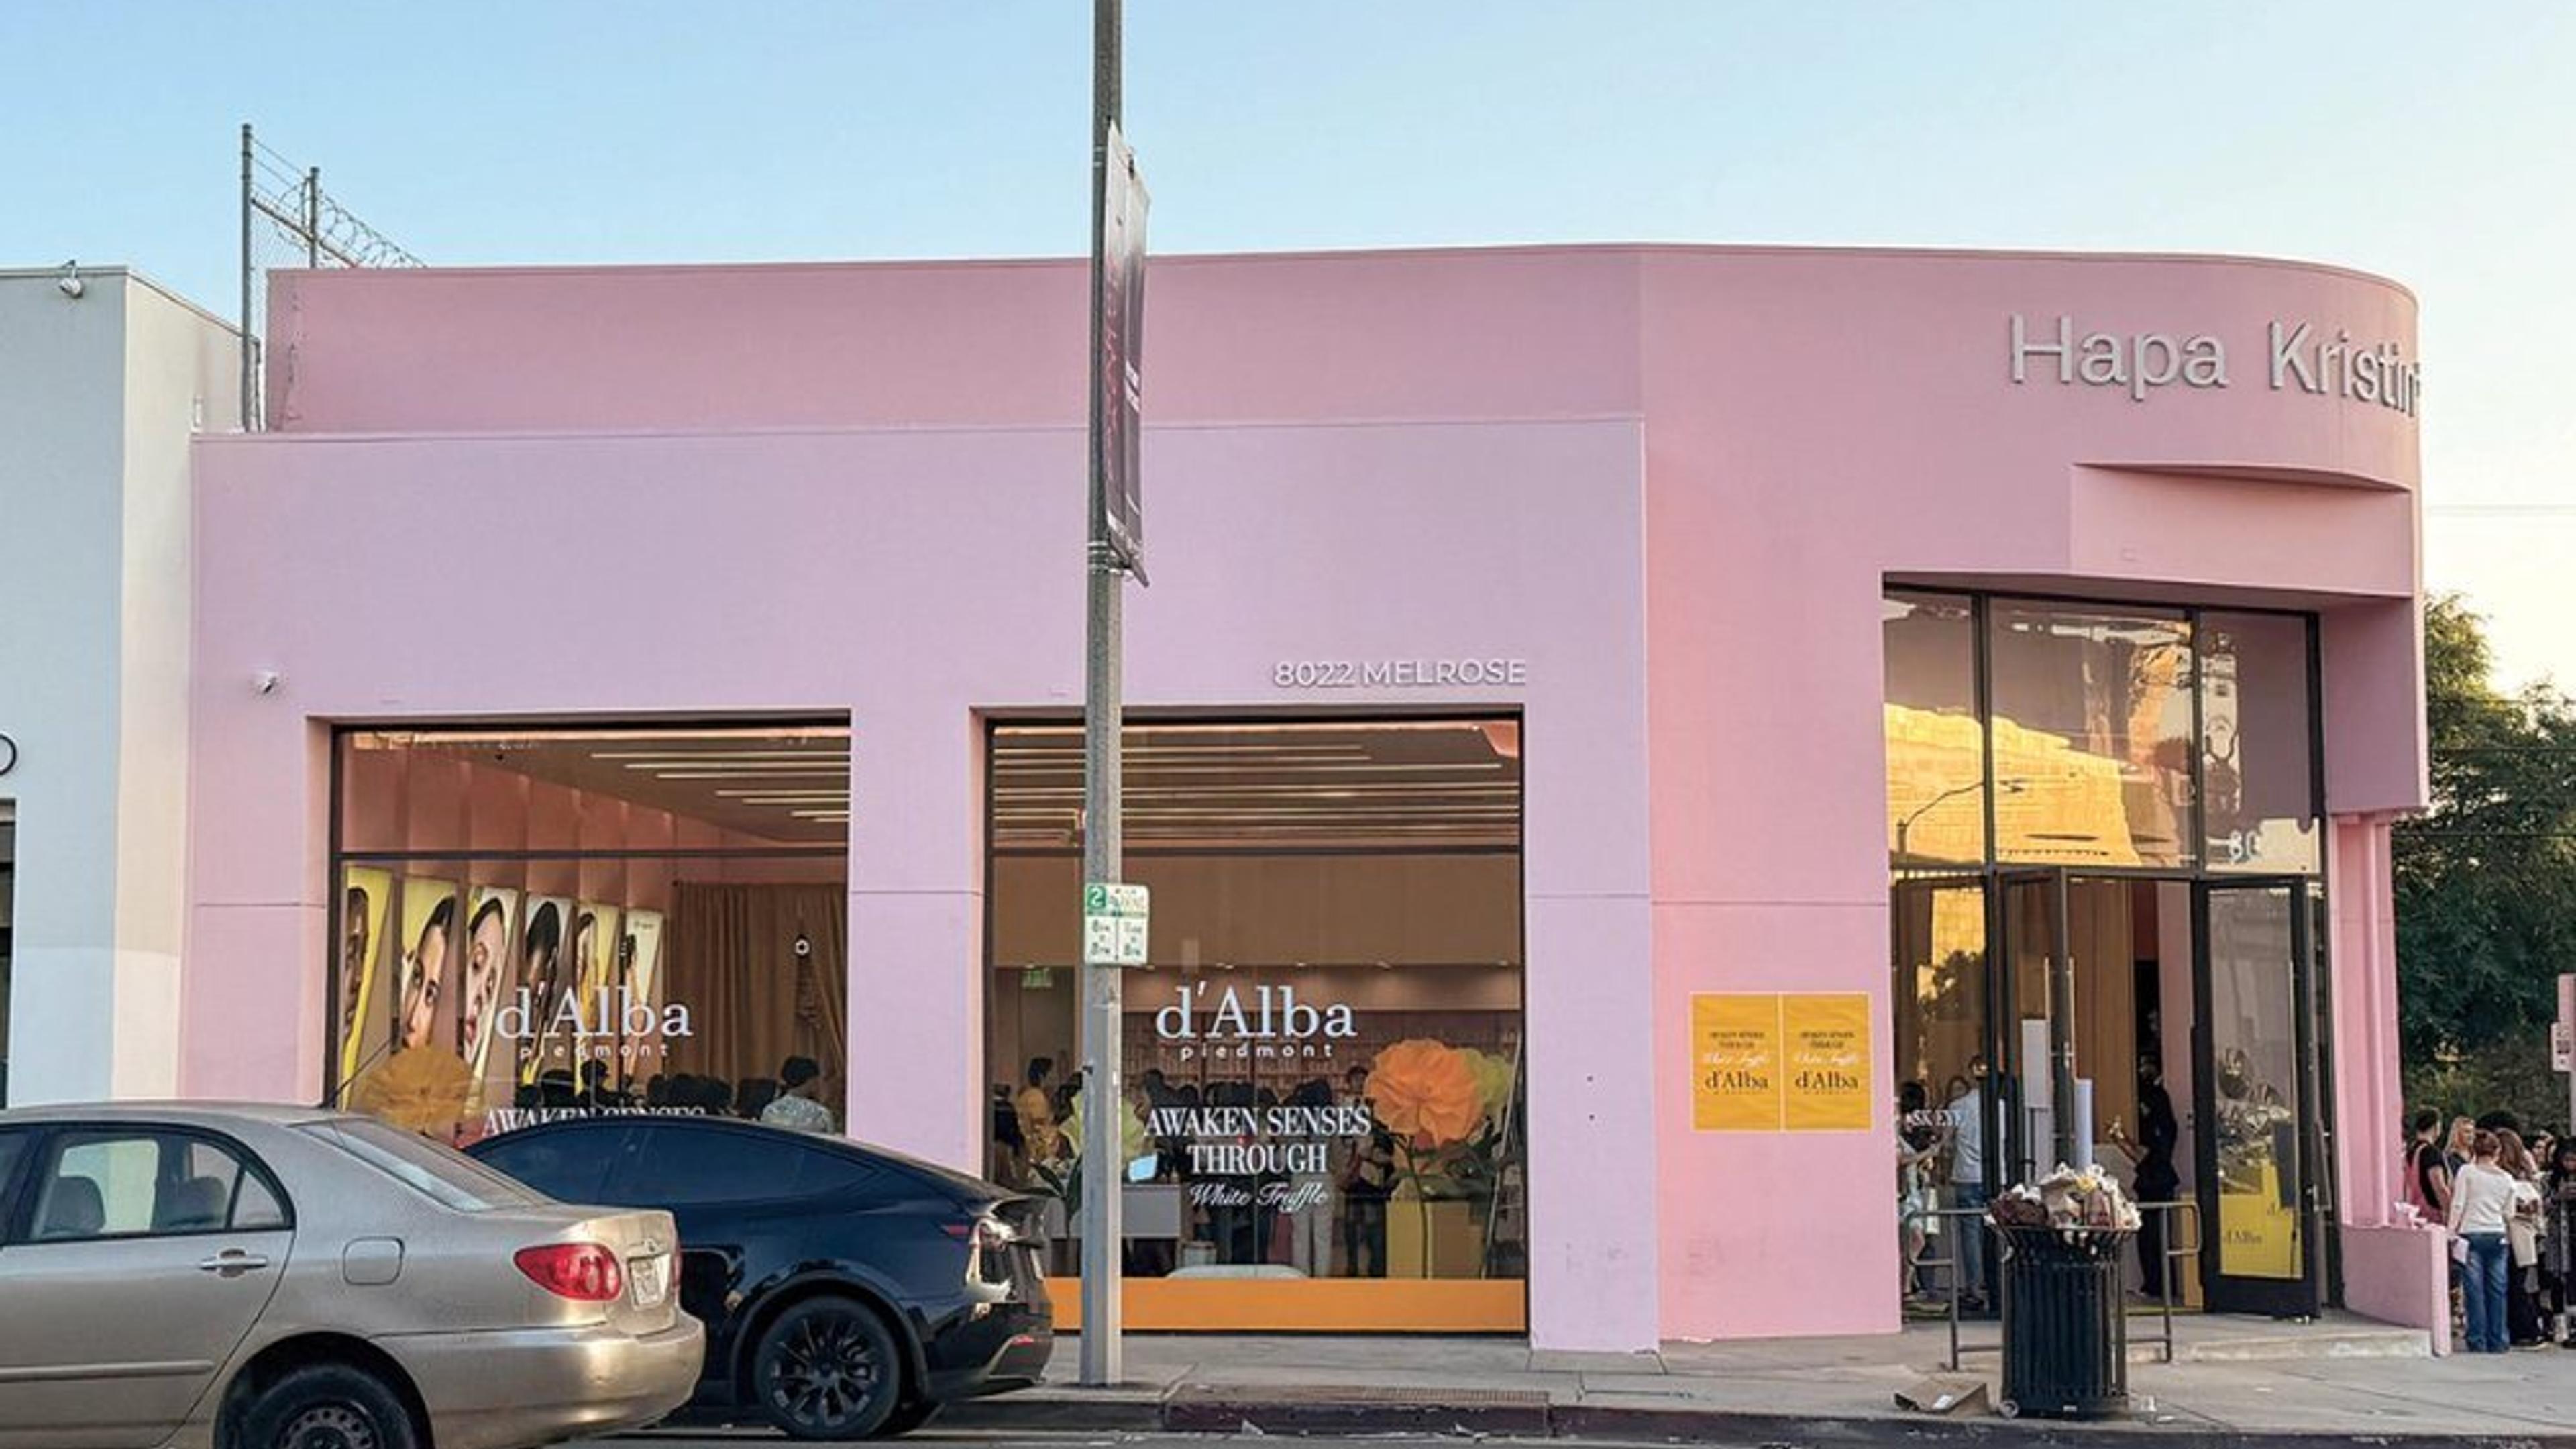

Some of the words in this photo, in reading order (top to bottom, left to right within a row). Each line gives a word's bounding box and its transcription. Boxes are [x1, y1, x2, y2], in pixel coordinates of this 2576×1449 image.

[2009, 315, 2228, 402] Hapa
[1274, 659, 1356, 688] 8022
[1363, 658, 1526, 686] MELROSE
[1091, 886, 1106, 908] 2
[495, 981, 694, 1039] d'Alba
[1156, 981, 1358, 1038] d'Alba
[519, 1043, 669, 1059] piedmont
[1181, 1042, 1333, 1061] piedmont
[1143, 1107, 1259, 1136] AWAKEN
[1267, 1107, 1371, 1136] SENSES
[1186, 1144, 1327, 1174] THROUGH
[1189, 1182, 1252, 1206] White
